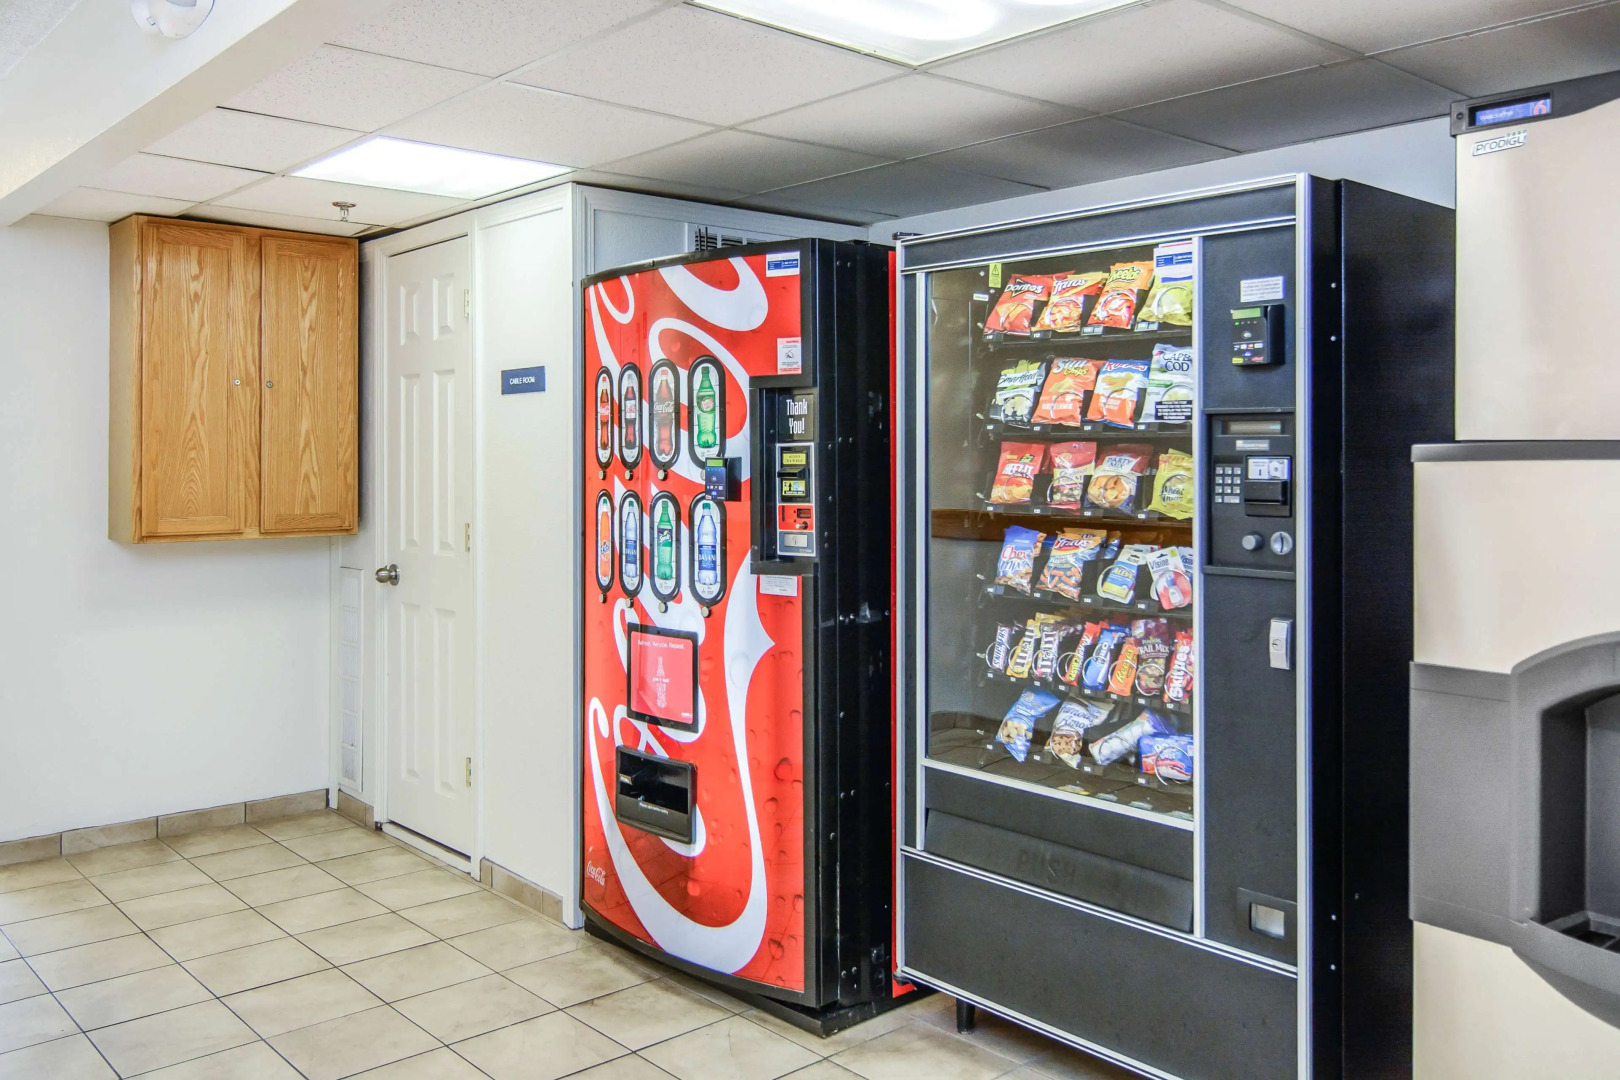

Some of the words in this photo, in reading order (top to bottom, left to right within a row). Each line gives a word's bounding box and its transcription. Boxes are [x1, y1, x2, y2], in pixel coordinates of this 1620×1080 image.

[1004, 283, 1045, 294] Doritos
[1165, 361, 1190, 372] COD
[522, 376, 535, 384] ROOM
[785, 399, 808, 416] Thank
[788, 418, 805, 435] You!
[1106, 456, 1133, 465] PARTY
[1002, 544, 1027, 560] Chex
[993, 627, 1007, 667] SNICKERS
